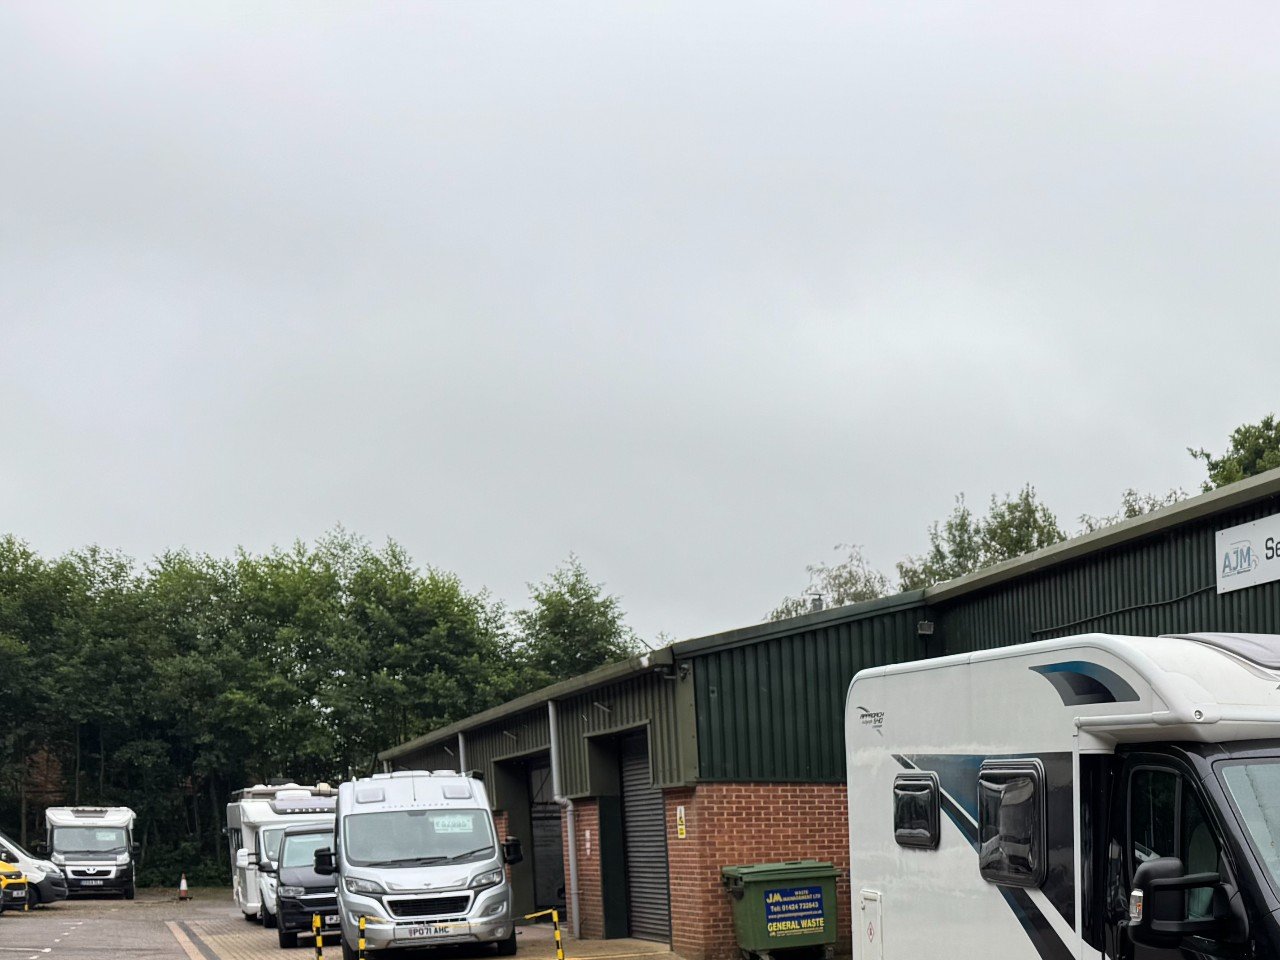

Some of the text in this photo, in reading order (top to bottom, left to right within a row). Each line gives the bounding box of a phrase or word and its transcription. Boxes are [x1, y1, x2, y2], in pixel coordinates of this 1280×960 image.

[1222, 545, 1252, 574] AJM
[768, 918, 824, 931] GENERAL WASTE
